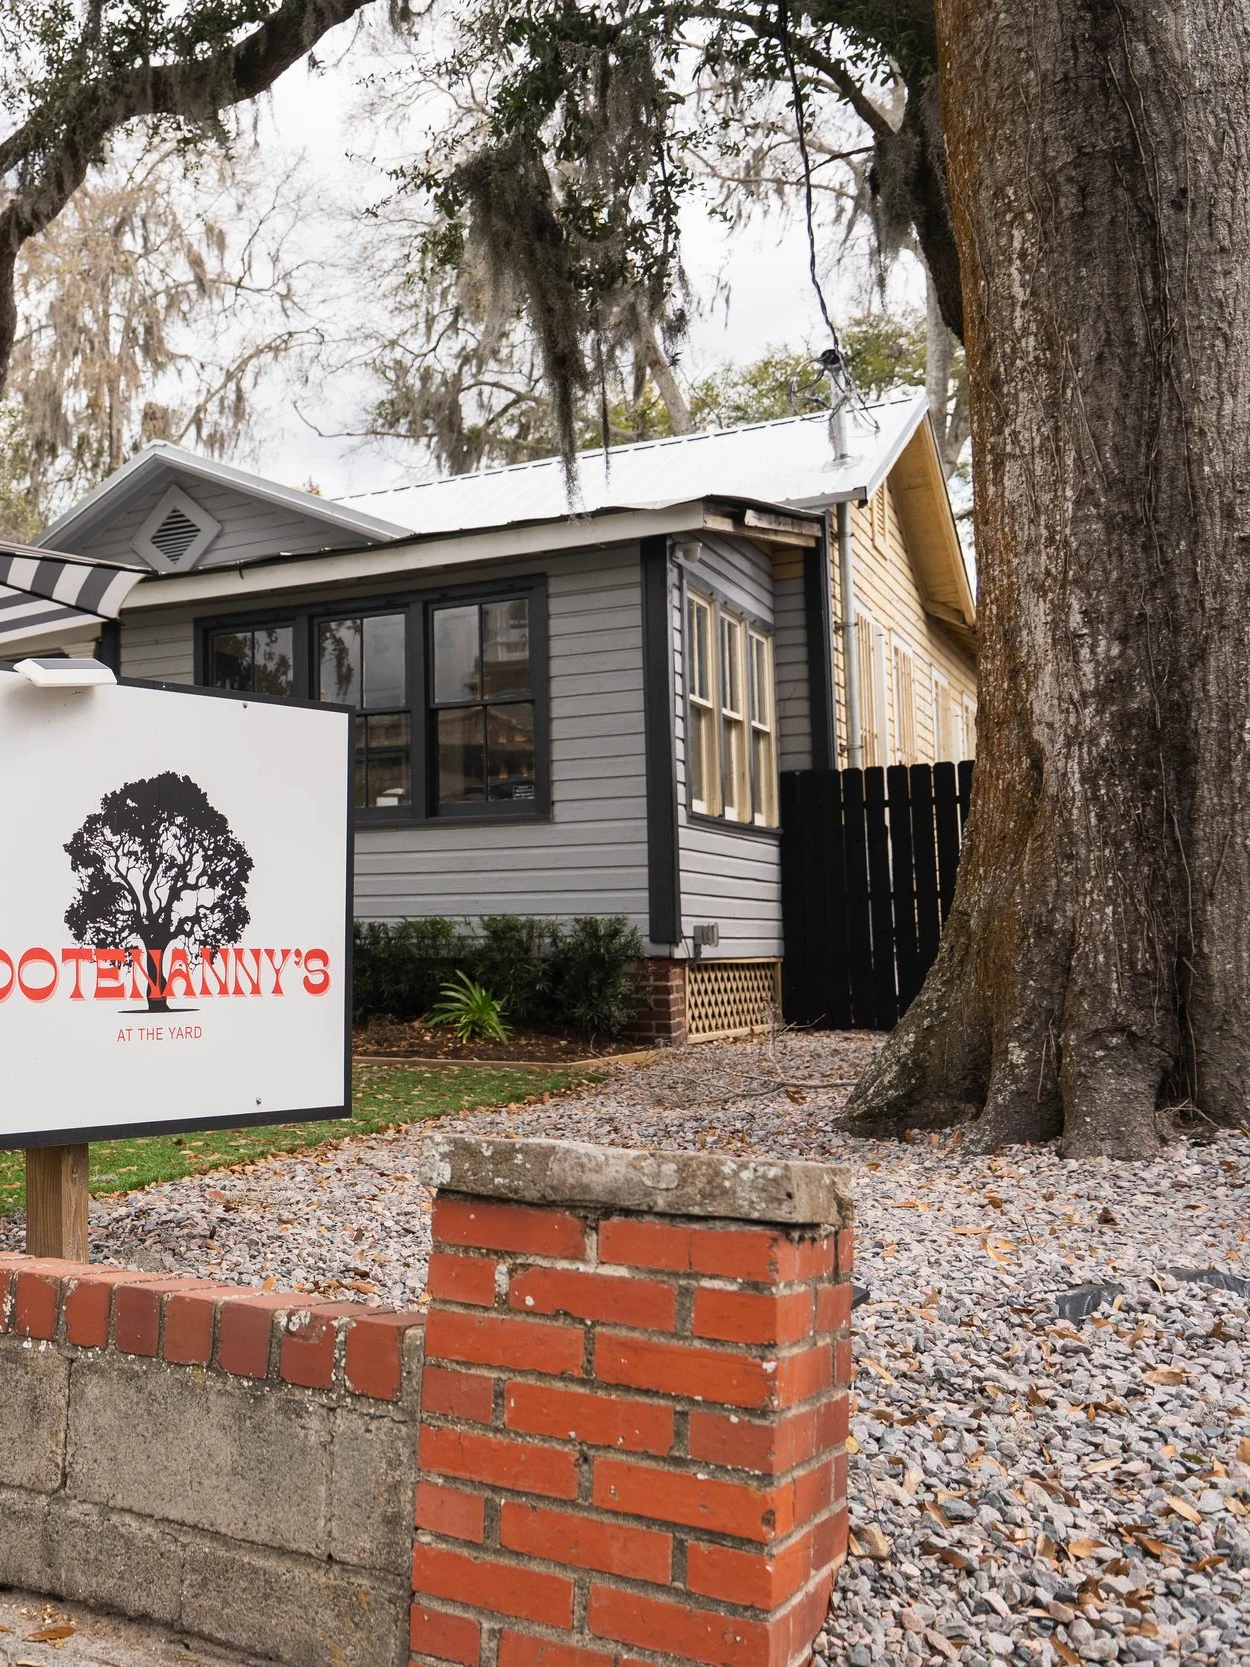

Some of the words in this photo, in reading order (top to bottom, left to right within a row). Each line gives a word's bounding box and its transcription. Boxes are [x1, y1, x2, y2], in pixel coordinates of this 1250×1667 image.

[117, 1028, 133, 1042] AT
[138, 1027, 163, 1041] THE
[168, 1026, 202, 1040] YARD
